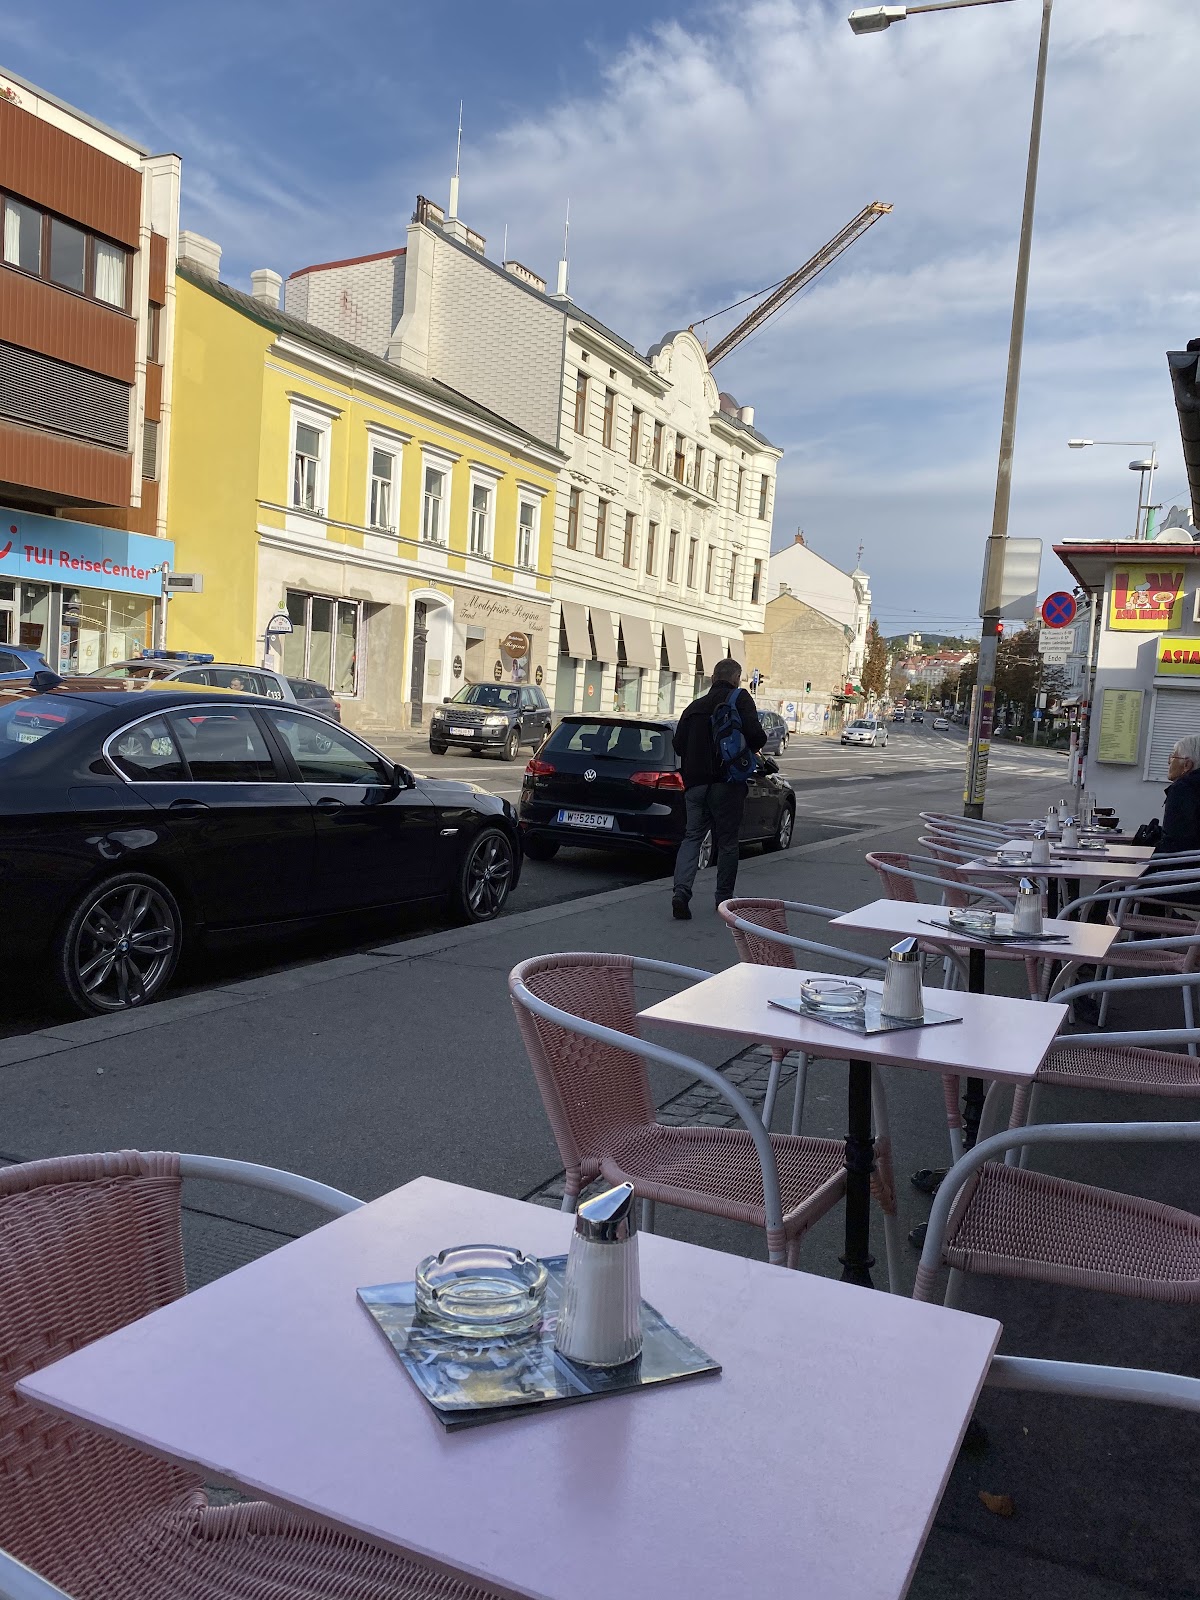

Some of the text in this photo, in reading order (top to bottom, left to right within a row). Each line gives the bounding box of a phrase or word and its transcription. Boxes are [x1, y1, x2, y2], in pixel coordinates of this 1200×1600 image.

[24, 545, 150, 580] TUI ReiseCenter
[512, 604, 540, 622] Regina
[1115, 610, 1138, 620] ASIA
[1160, 649, 1200, 665] ASIA
